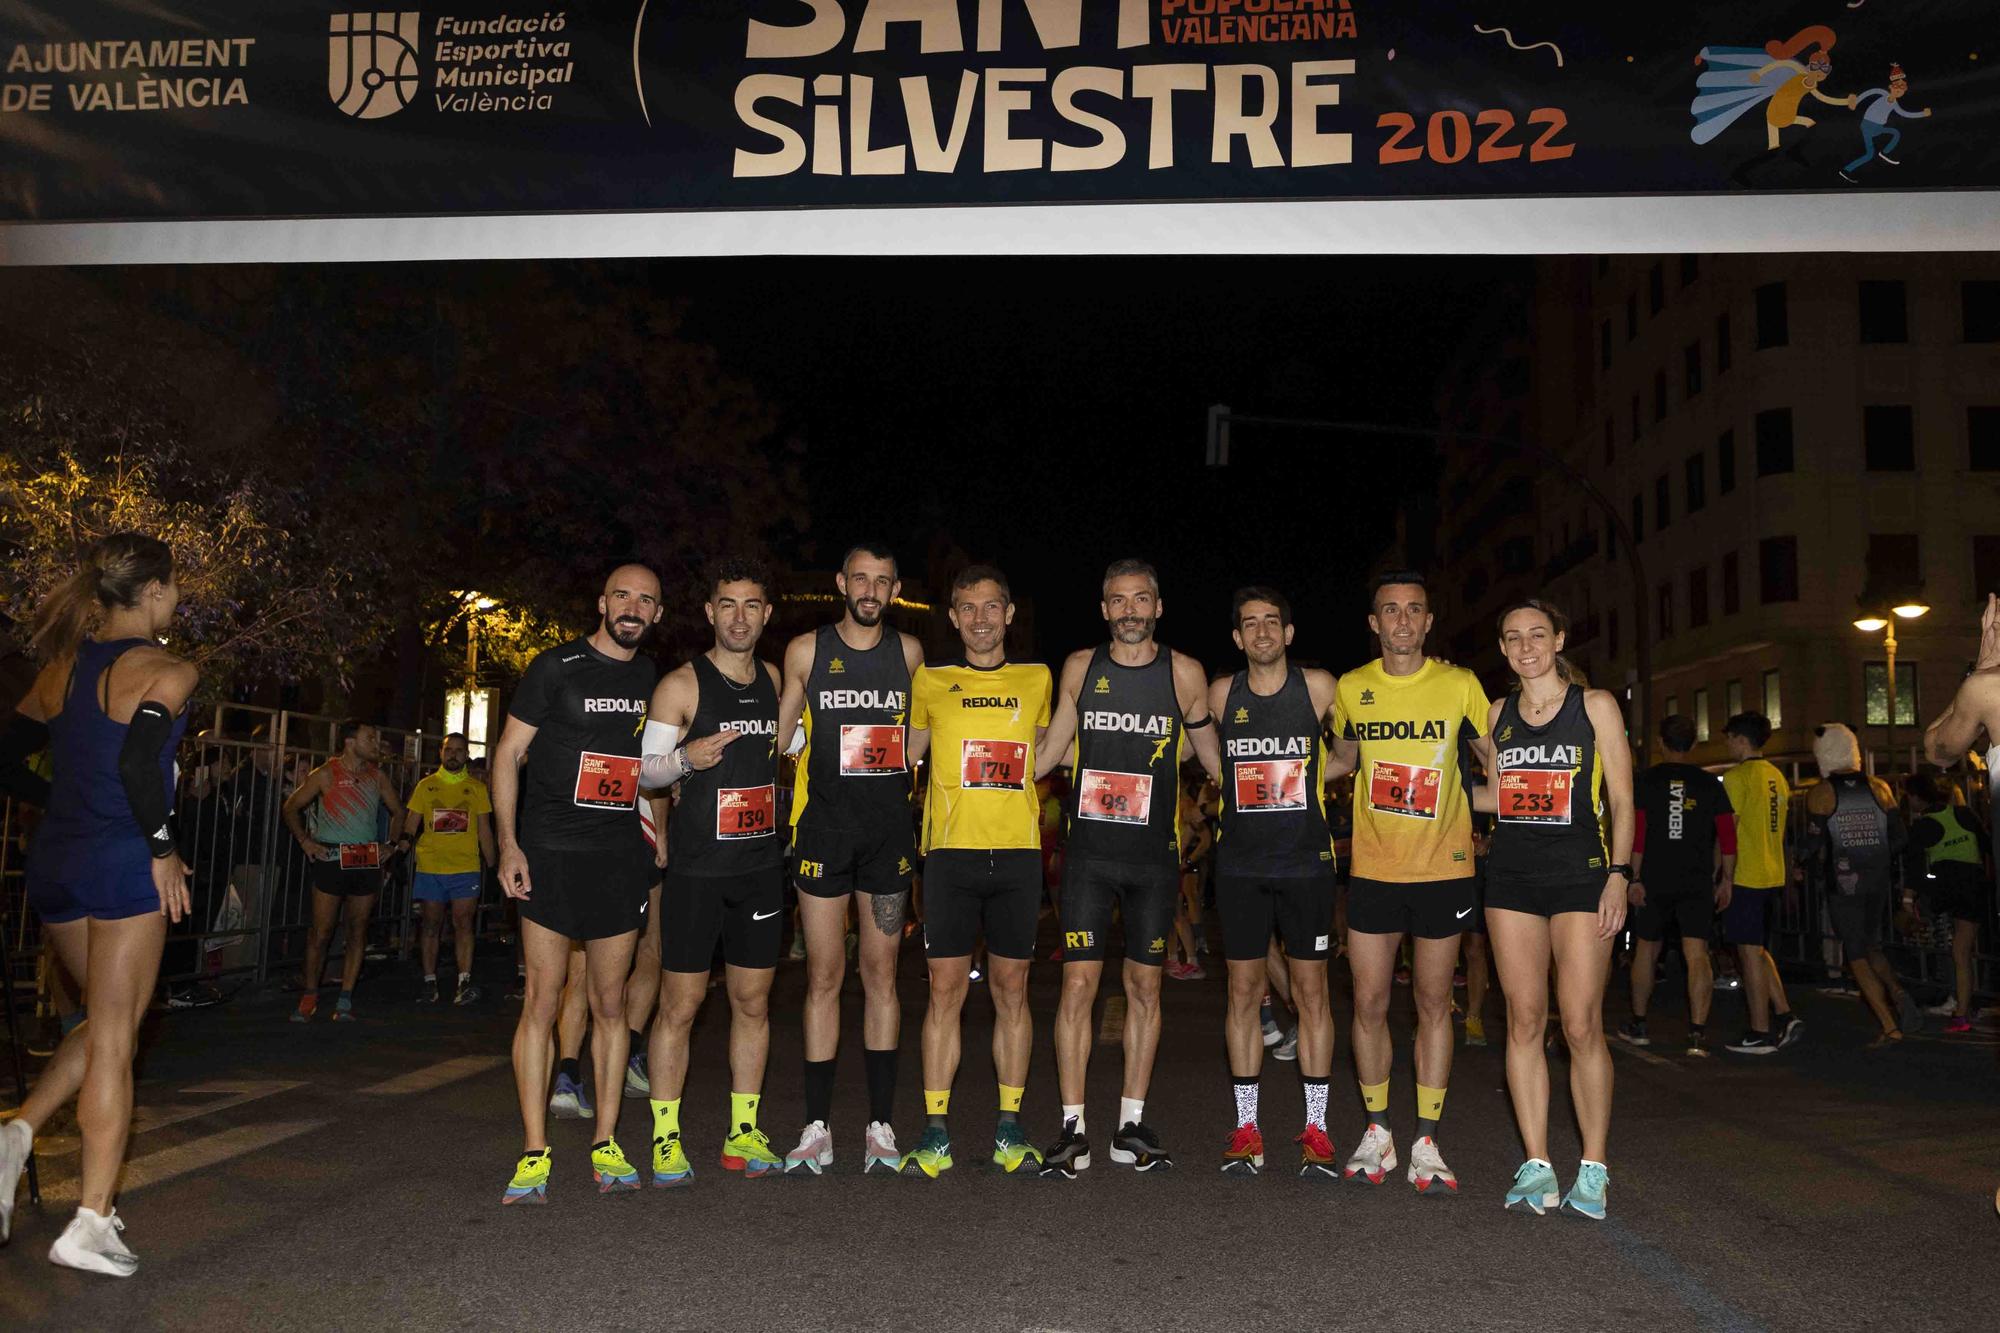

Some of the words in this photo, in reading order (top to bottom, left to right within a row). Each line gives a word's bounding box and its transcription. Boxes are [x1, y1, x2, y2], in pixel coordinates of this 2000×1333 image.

[435, 12, 566, 36] Fundació
[7, 38, 255, 72] AJUNTAMENT
[435, 36, 571, 66] Esportiva
[435, 62, 574, 90] Municipal
[2, 84, 53, 112] DE
[68, 72, 249, 112] VALÈNCIA
[435, 90, 553, 112] València
[1377, 107, 1576, 165] 2022
[584, 698, 645, 713] REDOLAT
[820, 689, 902, 709] REDOLAT
[962, 697, 1018, 708] REDOLAT
[1083, 711, 1167, 735] REDOLAT
[1356, 720, 1445, 740] REDOLAT
[863, 747, 887, 764] 57
[1226, 736, 1306, 757] REDOLAT
[584, 758, 605, 768] SANT
[1497, 744, 1576, 771] REDOLAT
[980, 761, 1011, 779] 174
[1238, 767, 1257, 776] SANT
[1502, 775, 1521, 784] SANT
[598, 779, 624, 797] 62
[1512, 793, 1554, 812] 233
[1669, 783, 1684, 839] REDOLAT
[737, 809, 765, 828] 139
[1842, 838, 1880, 847] COMIDA
